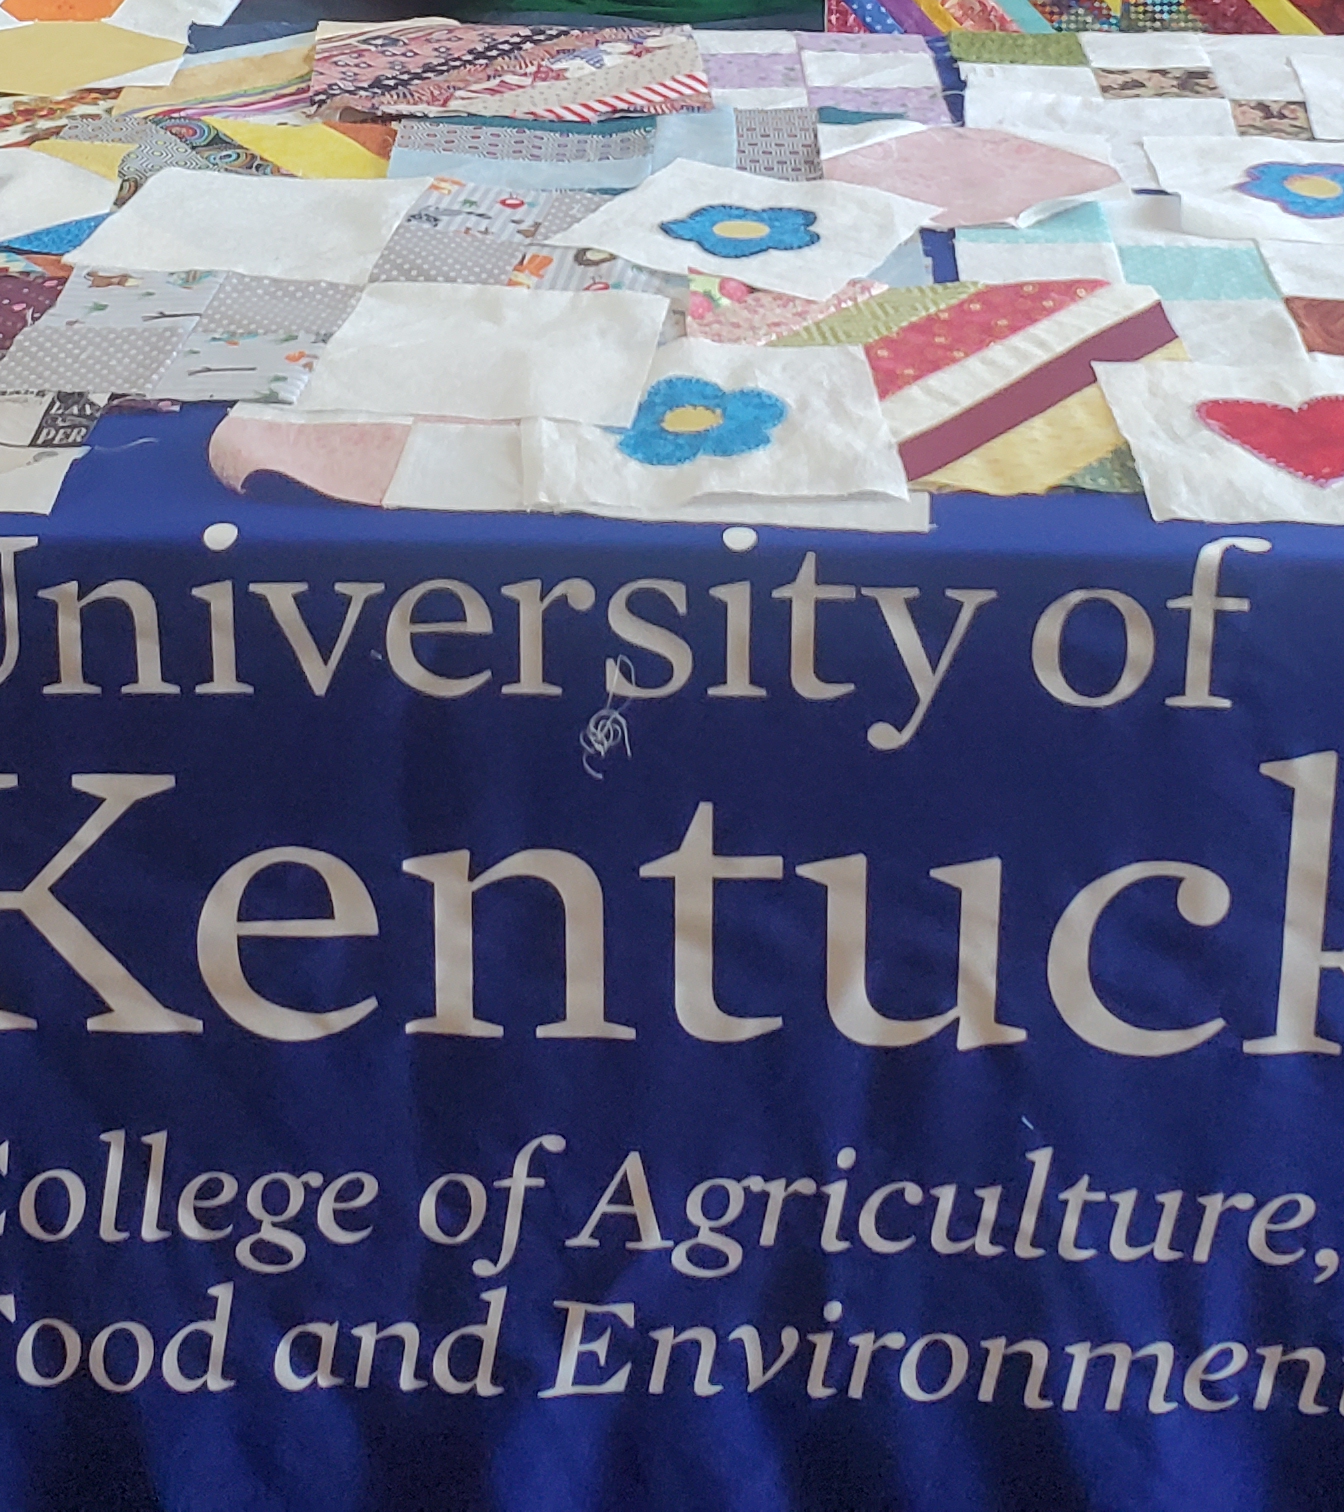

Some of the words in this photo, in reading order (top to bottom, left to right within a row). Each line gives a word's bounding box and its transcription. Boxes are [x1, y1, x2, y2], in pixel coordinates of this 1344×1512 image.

[1030, 536, 1273, 709] of
[418, 1134, 566, 1278] of
[565, 1146, 1340, 1284] Agriculture,
[273, 1286, 508, 1397] and
